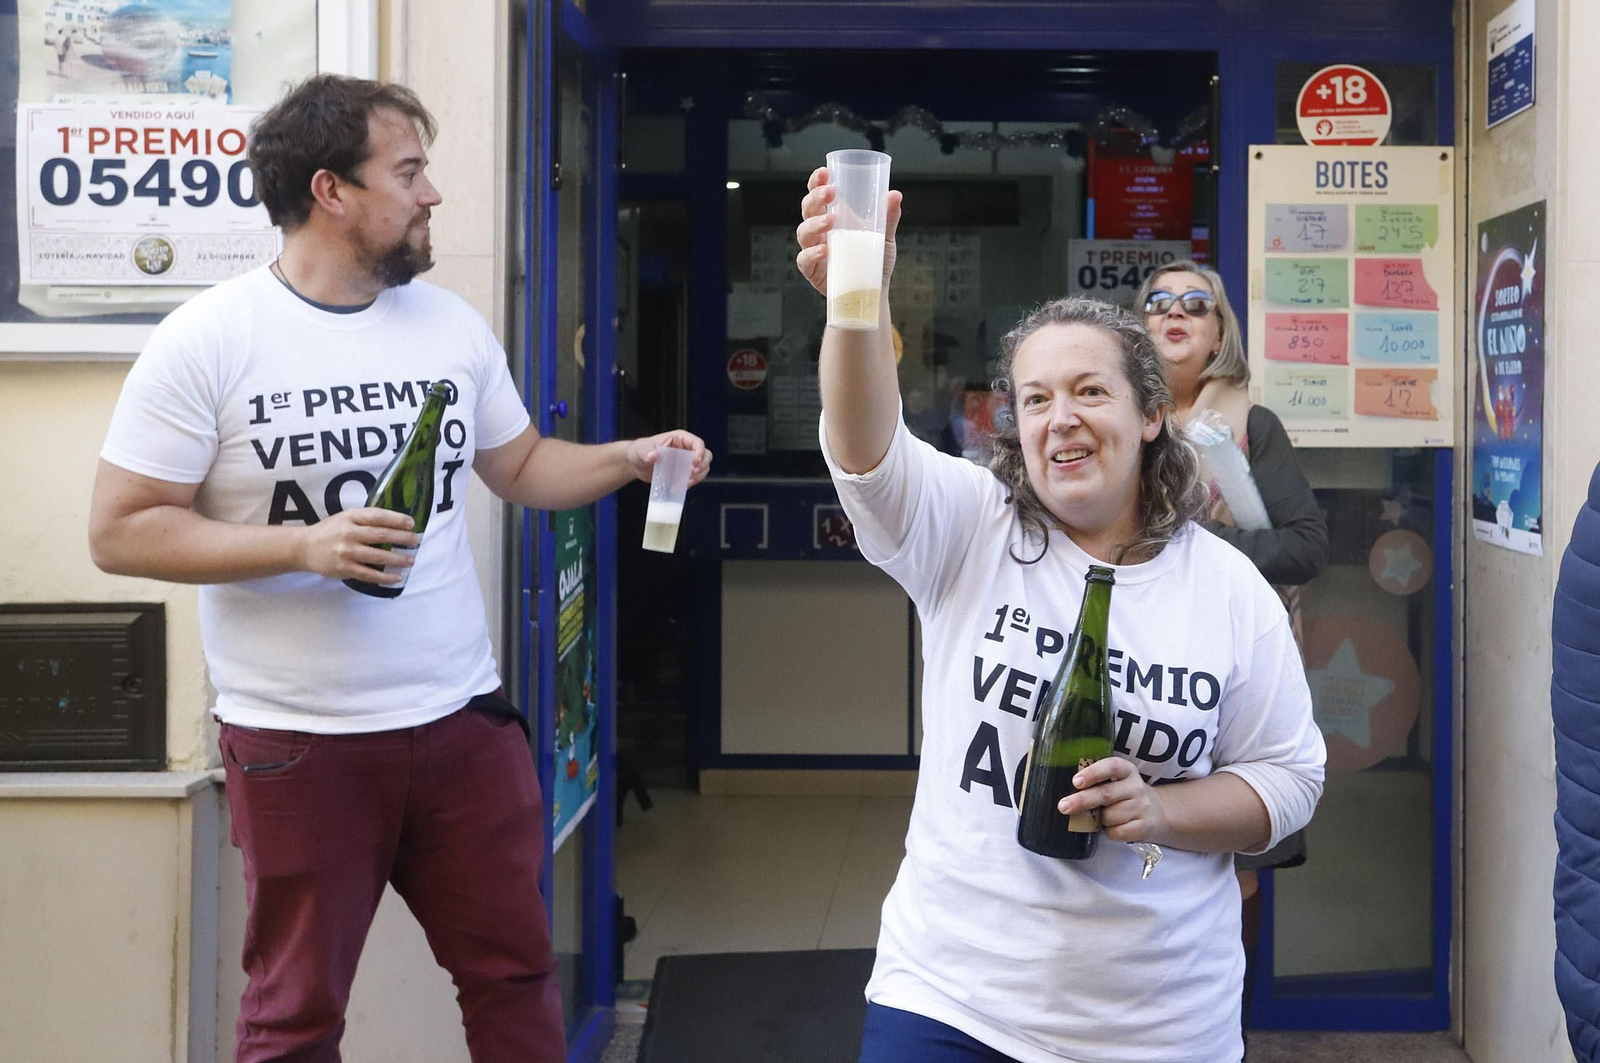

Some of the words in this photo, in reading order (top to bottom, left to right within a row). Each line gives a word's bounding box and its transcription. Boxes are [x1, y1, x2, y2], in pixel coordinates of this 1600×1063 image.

[1315, 74, 1368, 105] +18
[110, 110, 162, 120] VENDIDO
[166, 110, 195, 120] AQUÍ
[57, 127, 83, 154] 1er
[88, 127, 247, 156] PREMIO
[40, 157, 261, 207] 05490
[1316, 160, 1388, 189] BOTES
[86, 252, 126, 260] NAVIDAD
[209, 252, 255, 260] DICIEMBRE
[1100, 250, 1175, 265] PREMIO
[1288, 335, 1324, 349] 850
[1487, 328, 1499, 355] EL
[249, 390, 292, 425] 1er
[302, 378, 459, 418] PREMIO
[250, 419, 467, 470] VENDIO
[267, 452, 465, 526] AQÍ
[973, 655, 1208, 768] VEIDO
